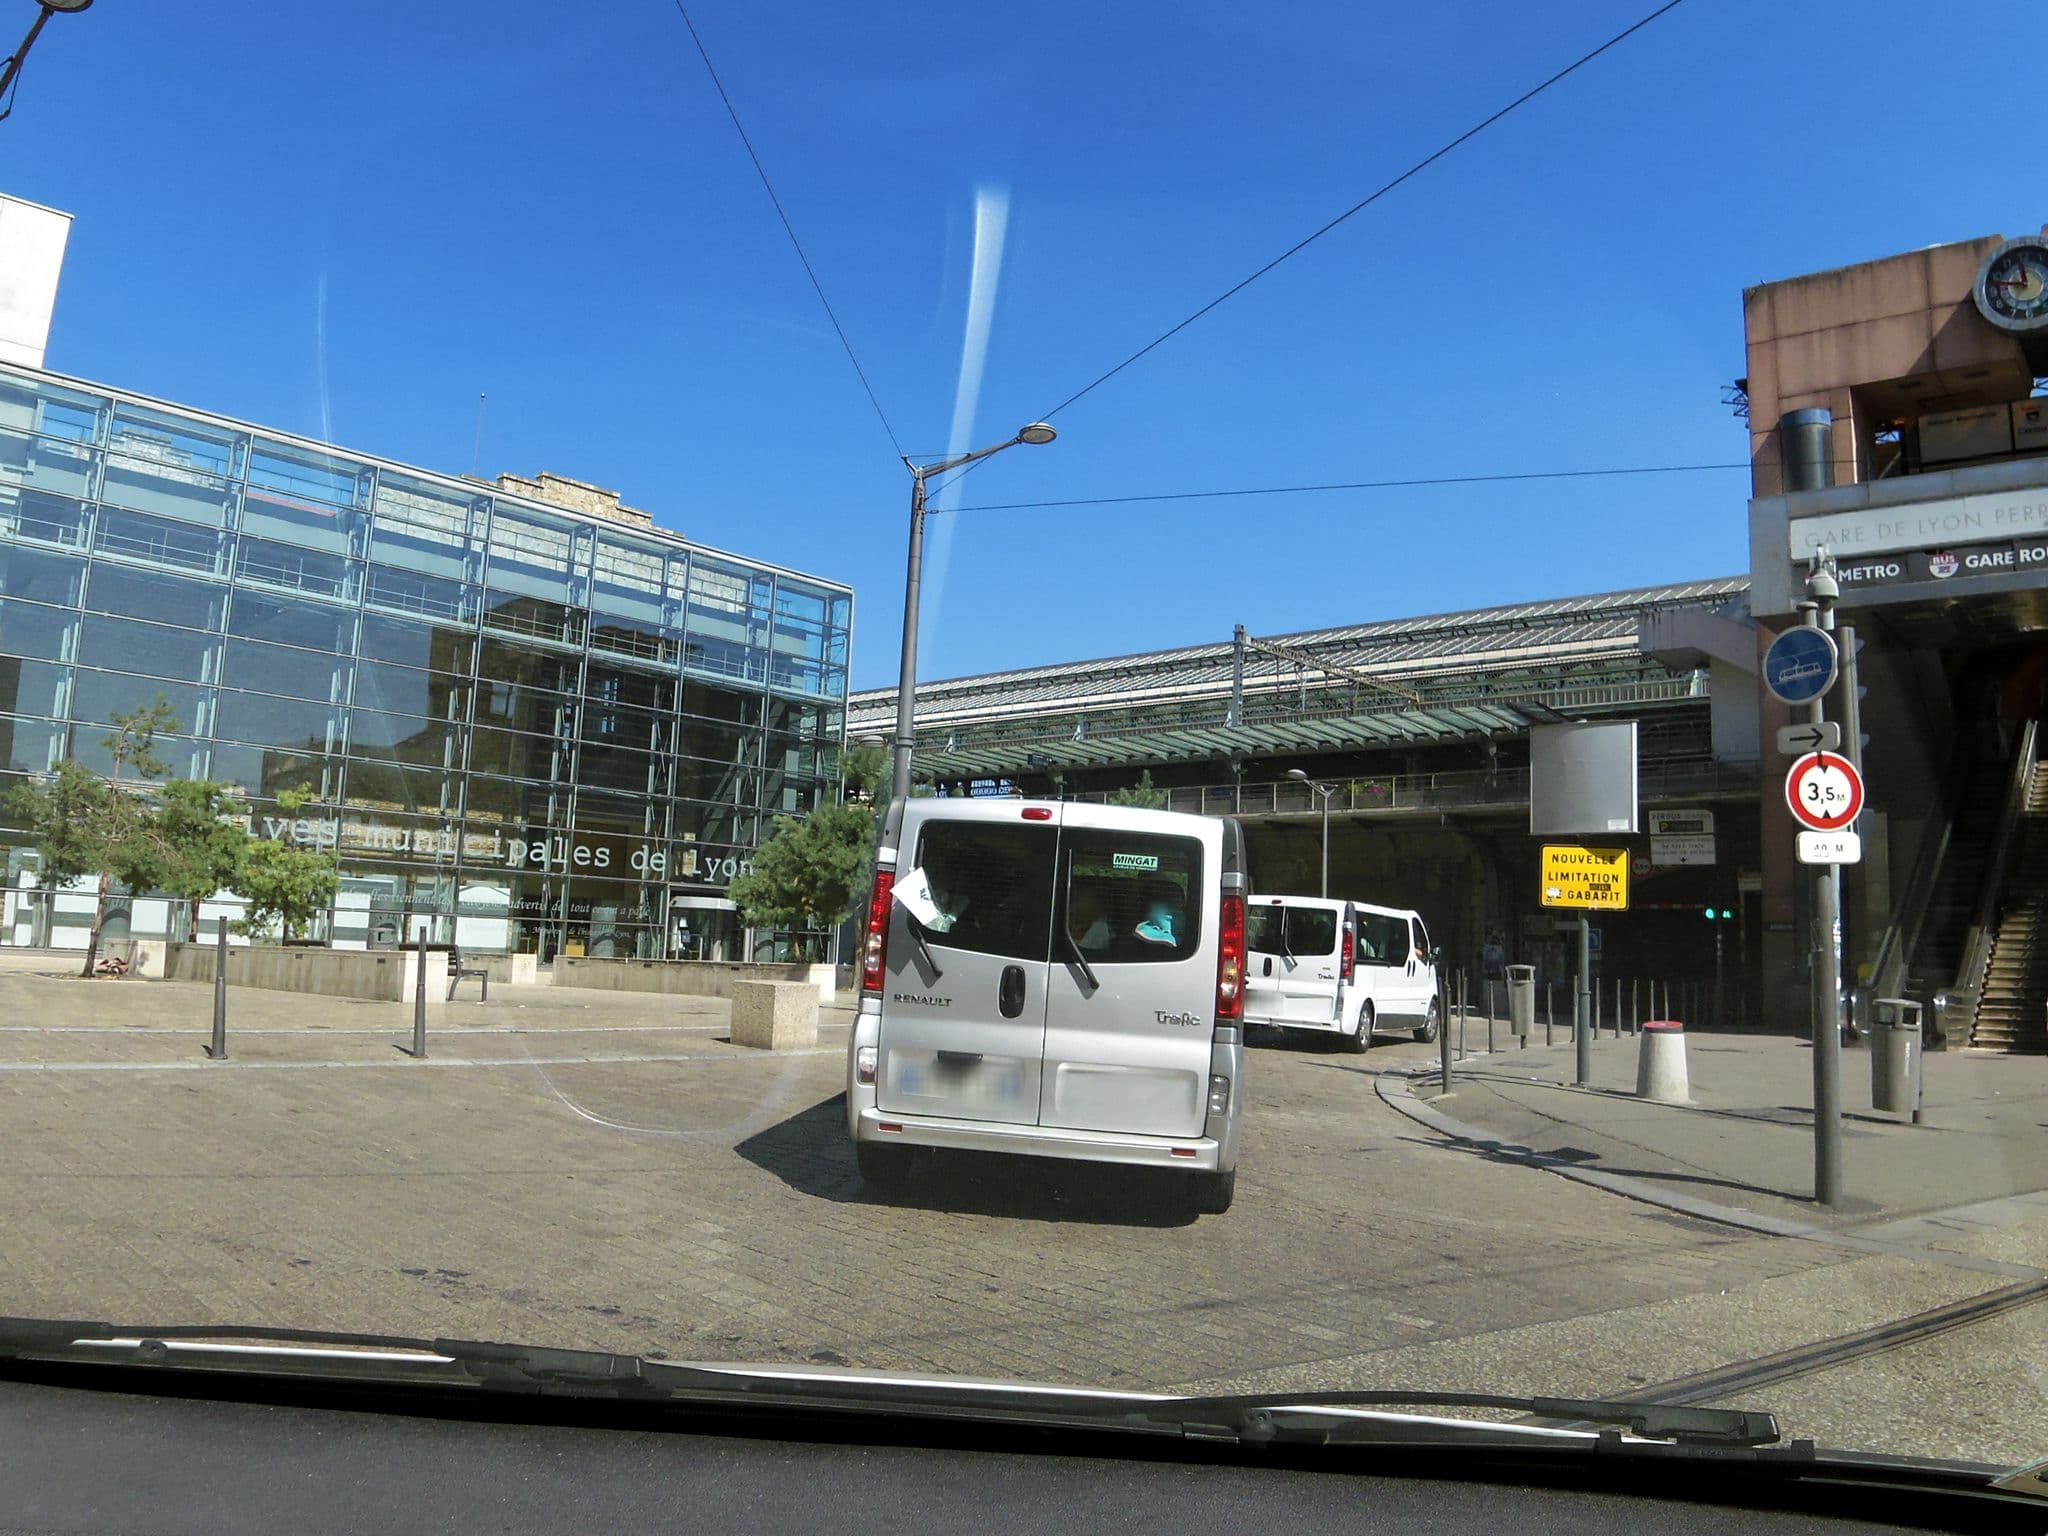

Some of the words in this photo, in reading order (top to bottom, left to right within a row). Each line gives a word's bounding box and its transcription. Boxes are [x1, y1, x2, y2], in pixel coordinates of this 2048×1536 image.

[1804, 528, 1865, 548] GARE
[1878, 521, 1906, 540] DE
[1918, 512, 1982, 534] LYON
[1932, 555, 1956, 566] BUS
[1965, 552, 2015, 569] GARE
[2020, 547, 2048, 564] RO
[1838, 564, 1901, 583] METRO
[631, 845, 666, 872] de
[1115, 855, 1156, 866] MINGAT
[1552, 854, 1616, 865] NOUVELLE
[1548, 872, 1619, 883] LIMITATION
[1567, 890, 1620, 902] GABARIT
[570, 903, 590, 914] tout
[894, 993, 952, 1007] RENAULT
[1154, 1010, 1201, 1026] Trafic
